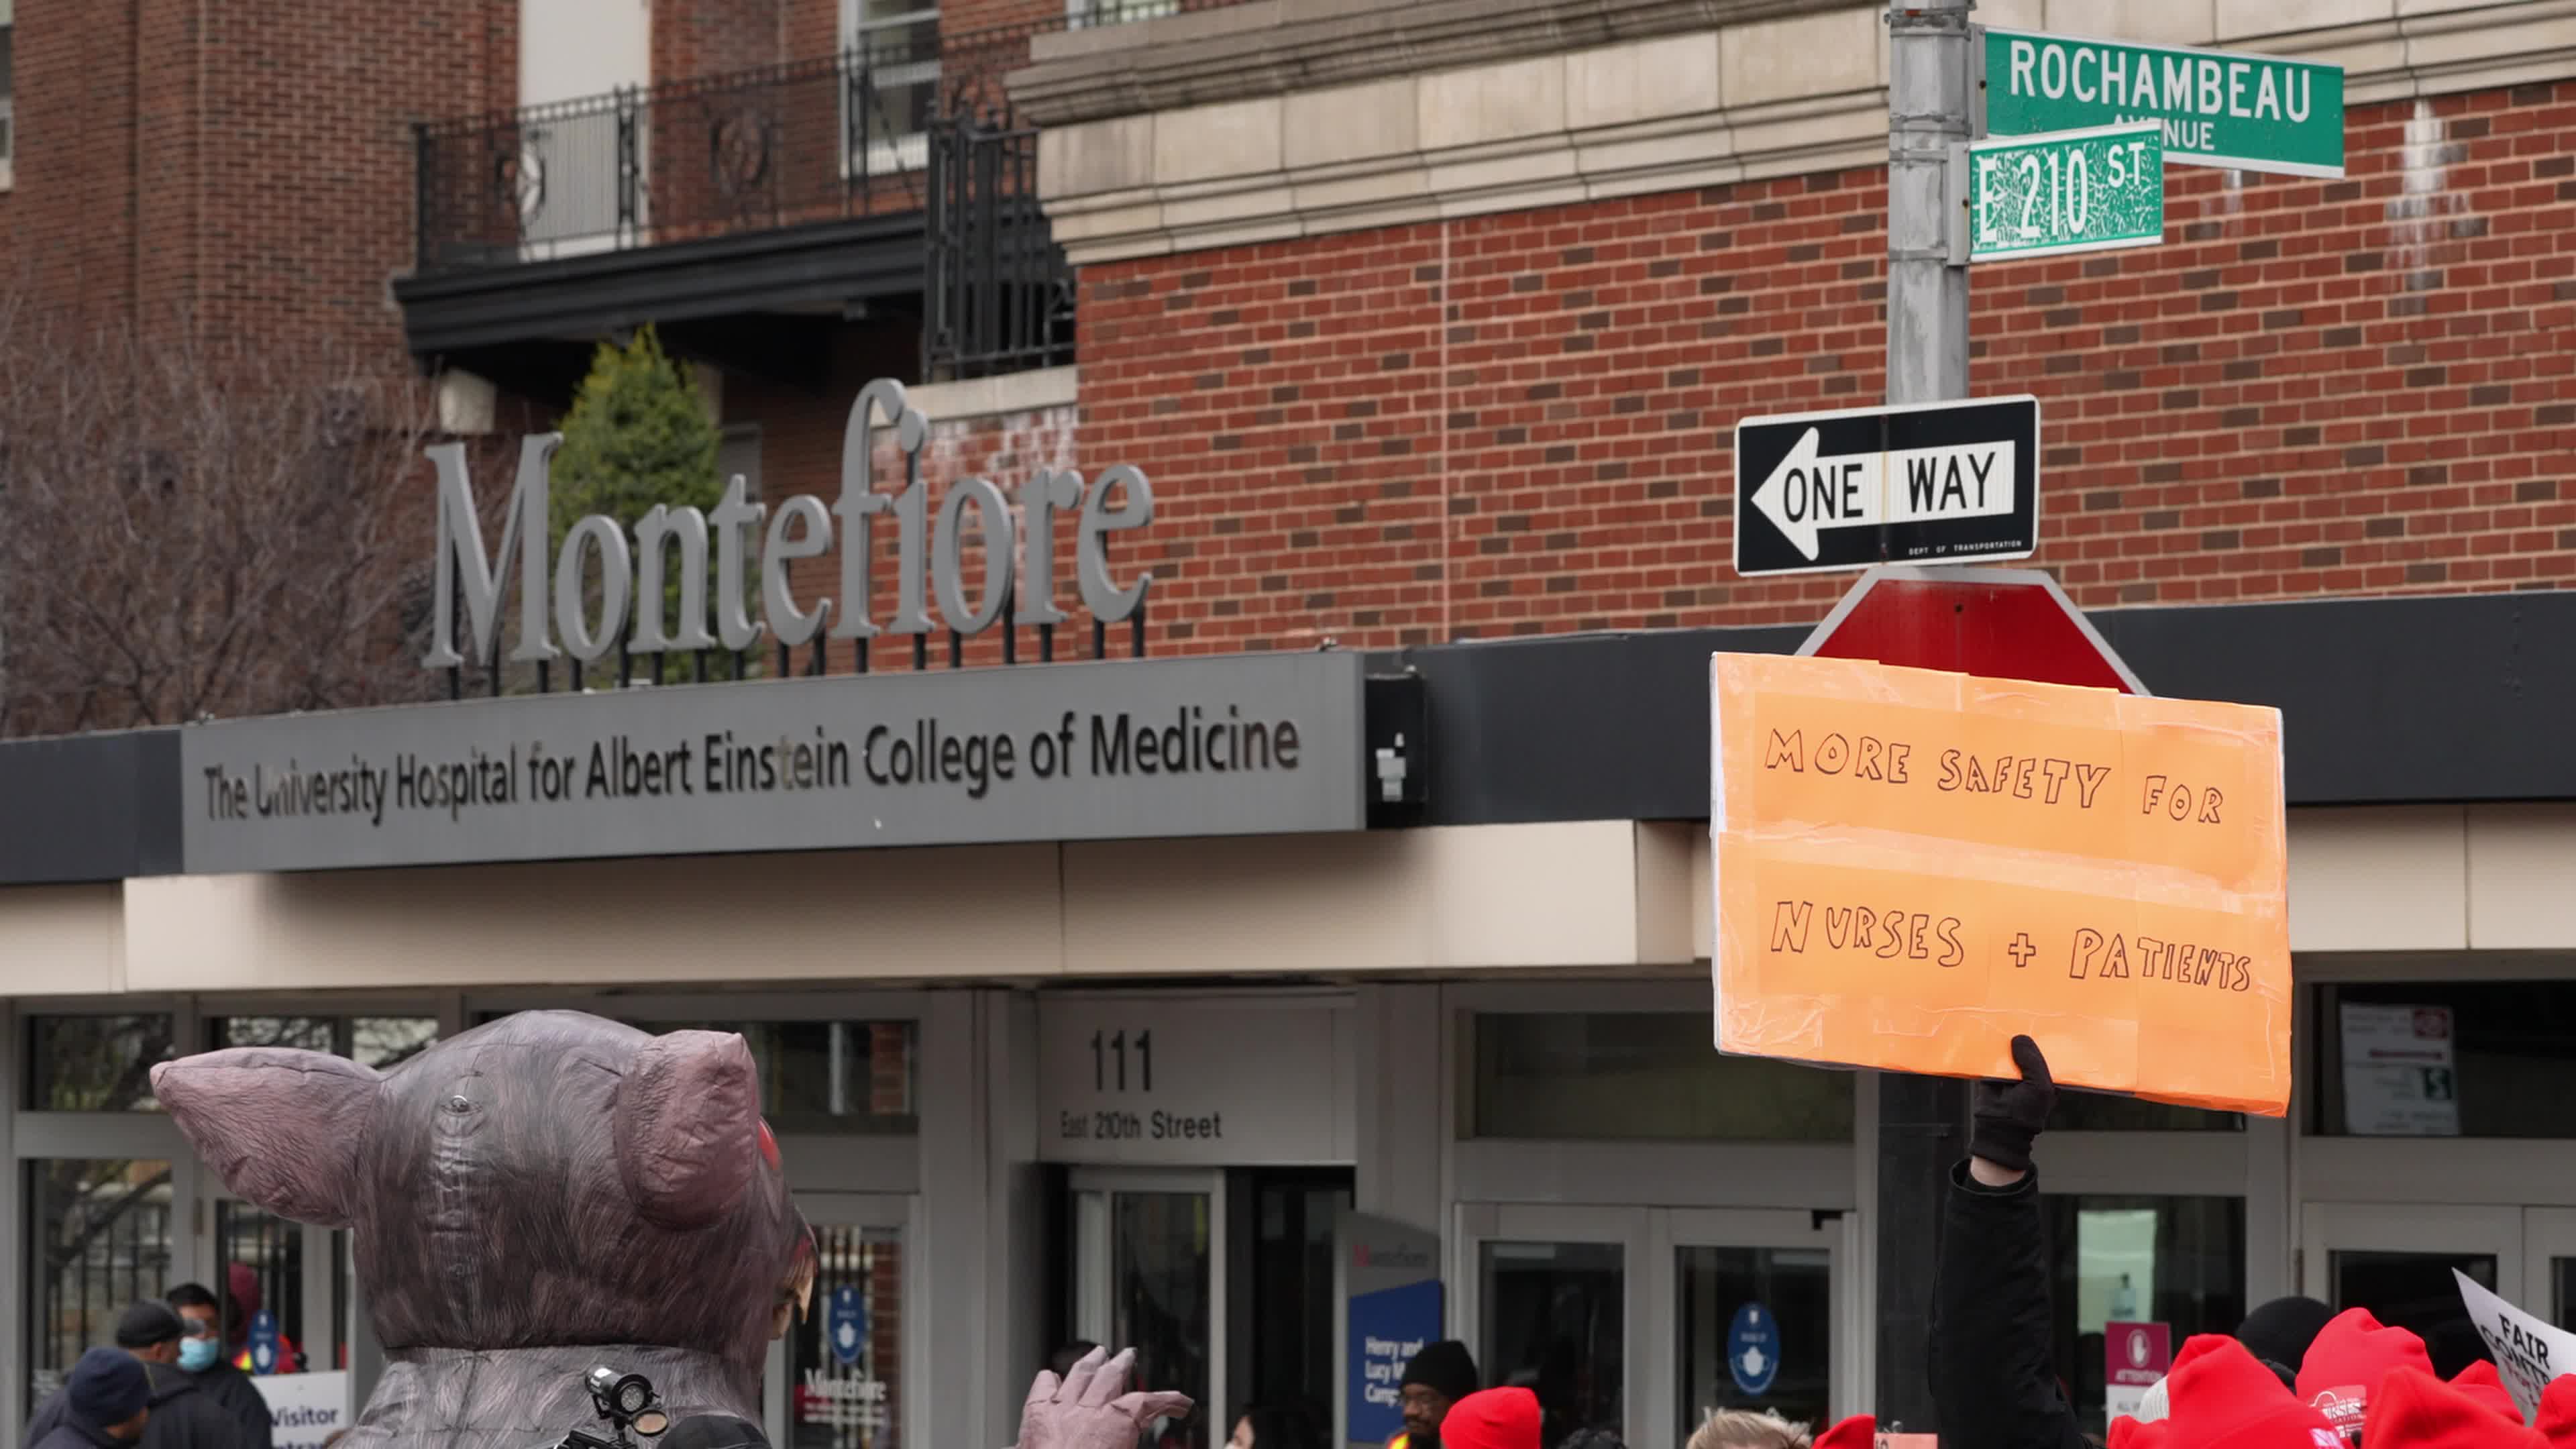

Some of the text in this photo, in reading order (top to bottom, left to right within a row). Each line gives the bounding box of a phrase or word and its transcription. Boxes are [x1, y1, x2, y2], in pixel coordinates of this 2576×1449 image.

[2010, 41, 2311, 123] ROCHAMBEAU
[2114, 114, 2215, 151] NUE
[1978, 142, 2146, 242] E 210 ST
[1784, 451, 1996, 523] ONE WAY
[421, 377, 1155, 669] Montefiore
[1909, 539, 2022, 556] DEPT OF TRANSPORTATION
[204, 705, 1299, 826] The University Hospital for Albert Einstein College of Medicine
[1764, 728, 2224, 824] MORE SAFETY FOR
[1771, 900, 1964, 968] NURSES
[2070, 928, 2251, 992] PATIENTS
[1090, 1029, 1152, 1091] 111
[1061, 1109, 1222, 1140] East 210th Street
[2480, 1324, 2551, 1386] CONTR
[2498, 1312, 2551, 1370] FAIR
[270, 1405, 338, 1427] Visitor
